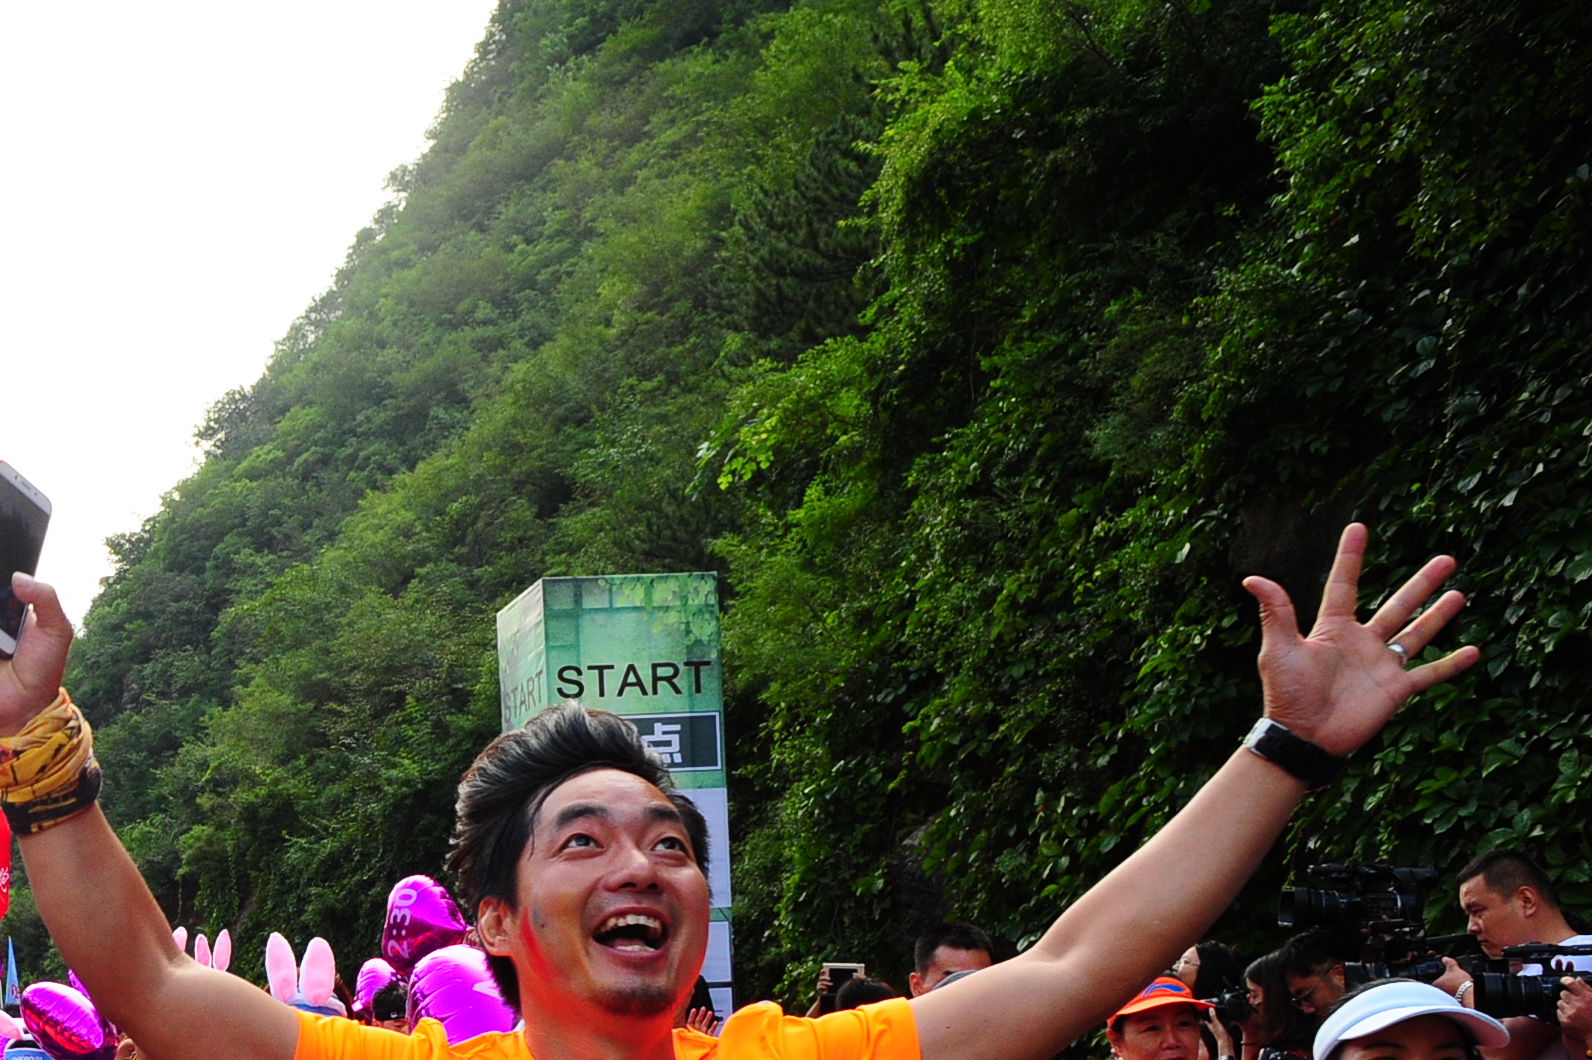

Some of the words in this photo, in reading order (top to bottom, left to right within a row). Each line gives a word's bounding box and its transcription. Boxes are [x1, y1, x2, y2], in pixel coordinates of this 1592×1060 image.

[557, 661, 711, 698] START
[641, 723, 682, 763] 点
[388, 888, 417, 958] 2:30
